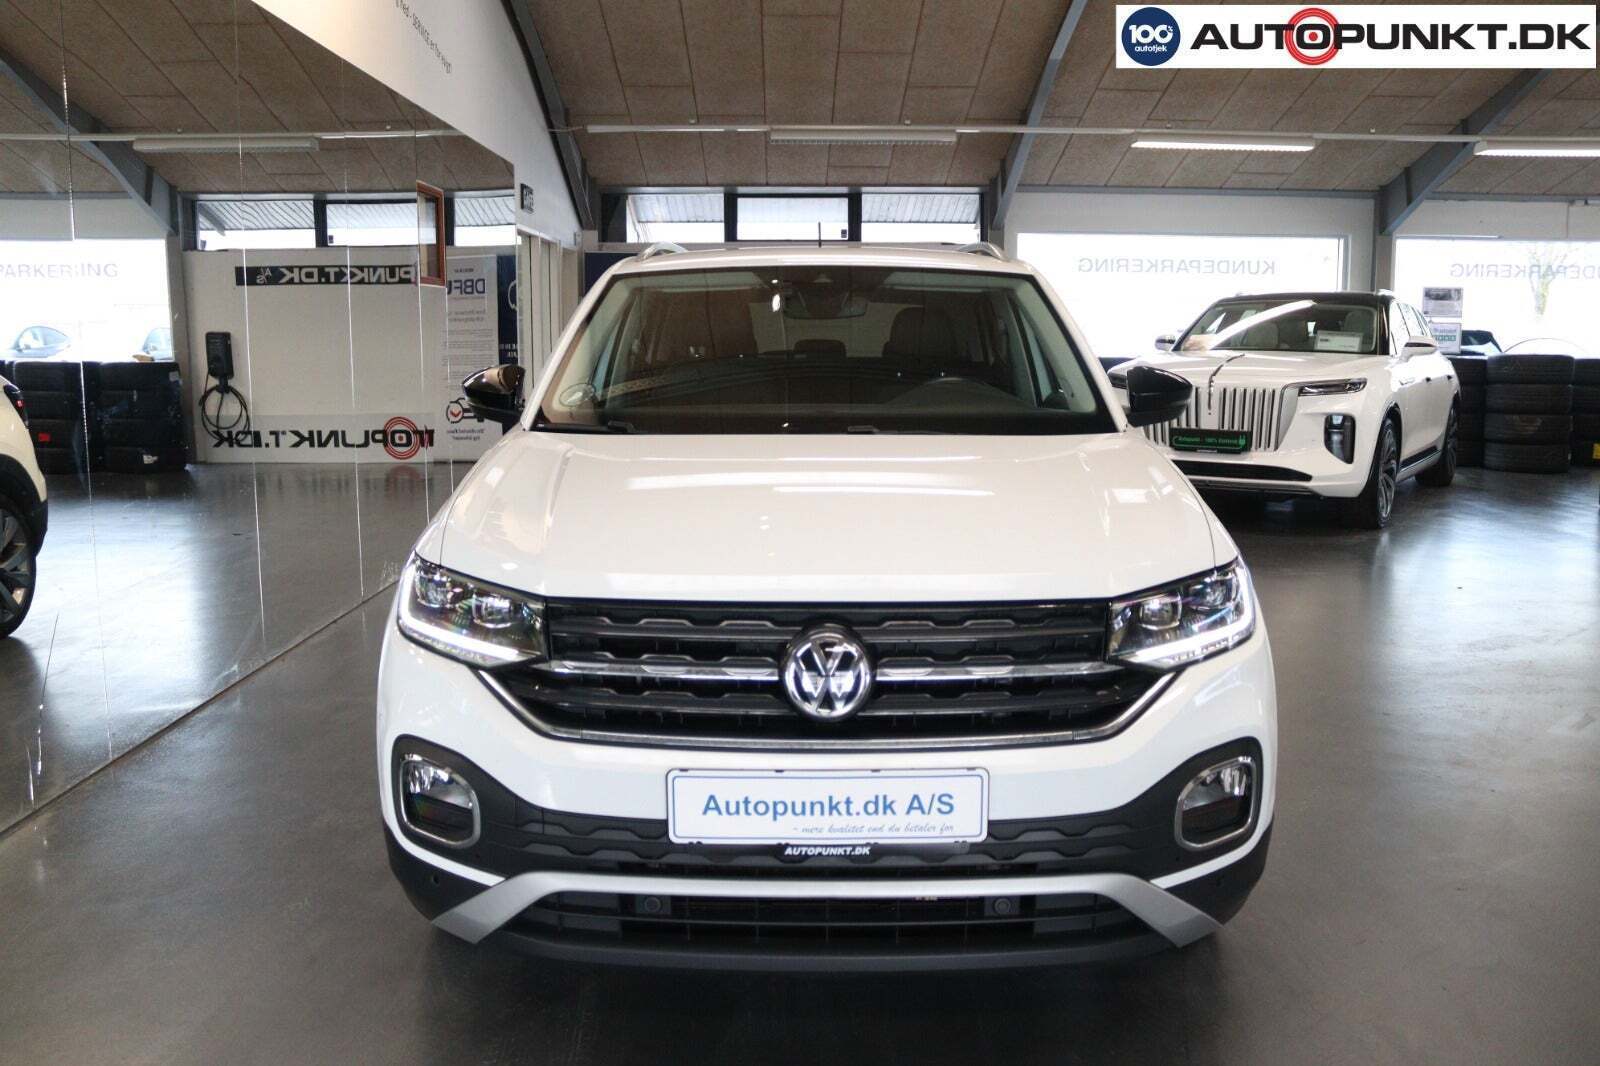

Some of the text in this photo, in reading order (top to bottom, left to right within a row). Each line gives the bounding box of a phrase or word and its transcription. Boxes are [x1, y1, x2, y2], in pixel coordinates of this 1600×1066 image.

[702, 792, 955, 821] Autopunkt.dk A/S
[939, 823, 955, 834] for
[784, 846, 871, 856] AUTOPUNKT.DK
